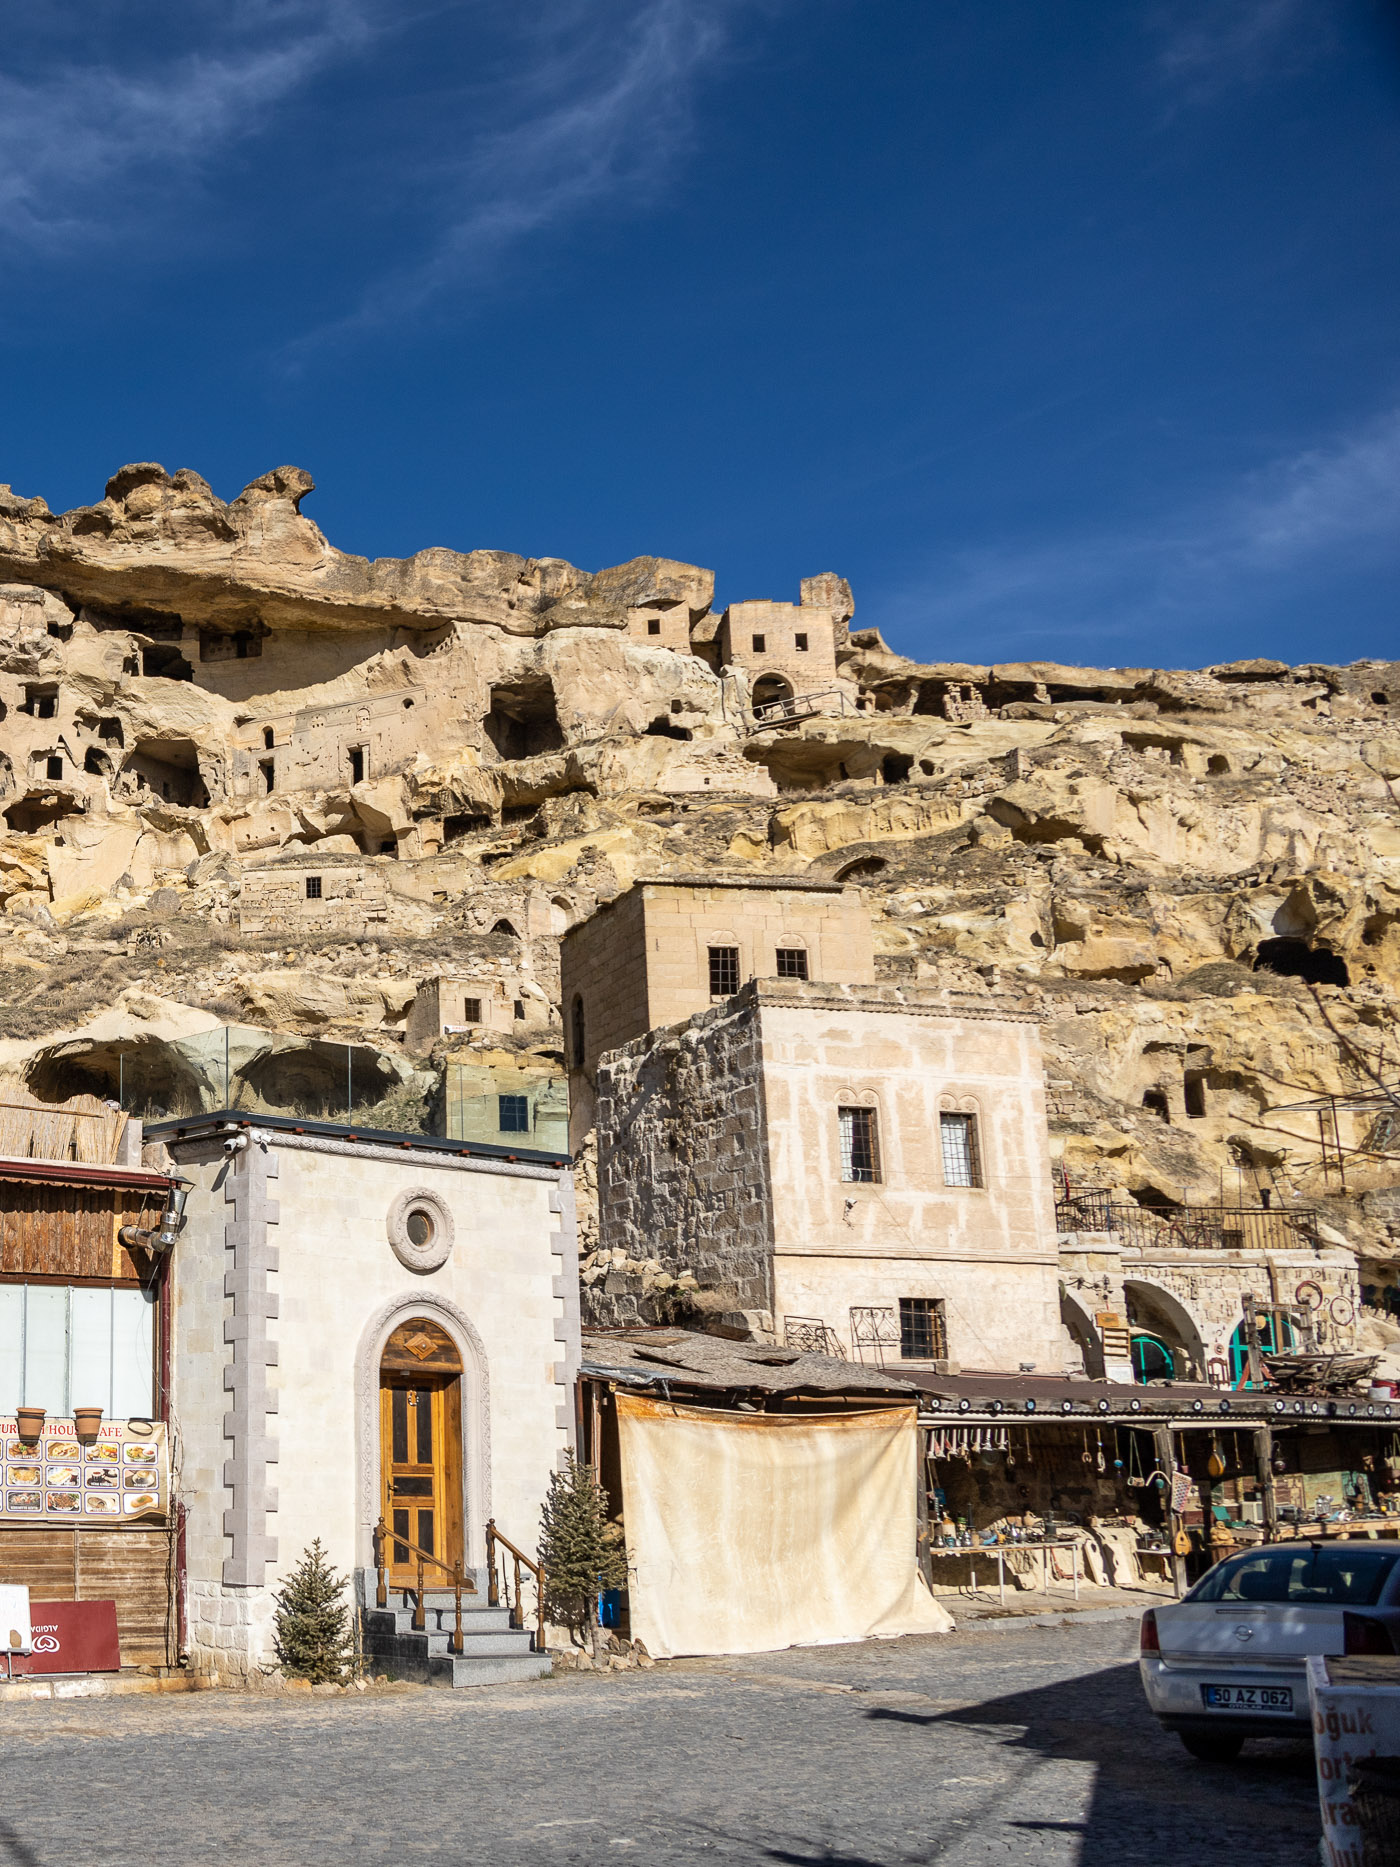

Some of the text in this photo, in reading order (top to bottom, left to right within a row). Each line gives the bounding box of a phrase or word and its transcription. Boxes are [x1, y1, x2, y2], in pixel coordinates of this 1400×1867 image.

[99, 1427, 122, 1437] AFE
[30, 1624, 59, 1633] ALGIDA
[1215, 1688, 1288, 1705] 50 AZ 062
